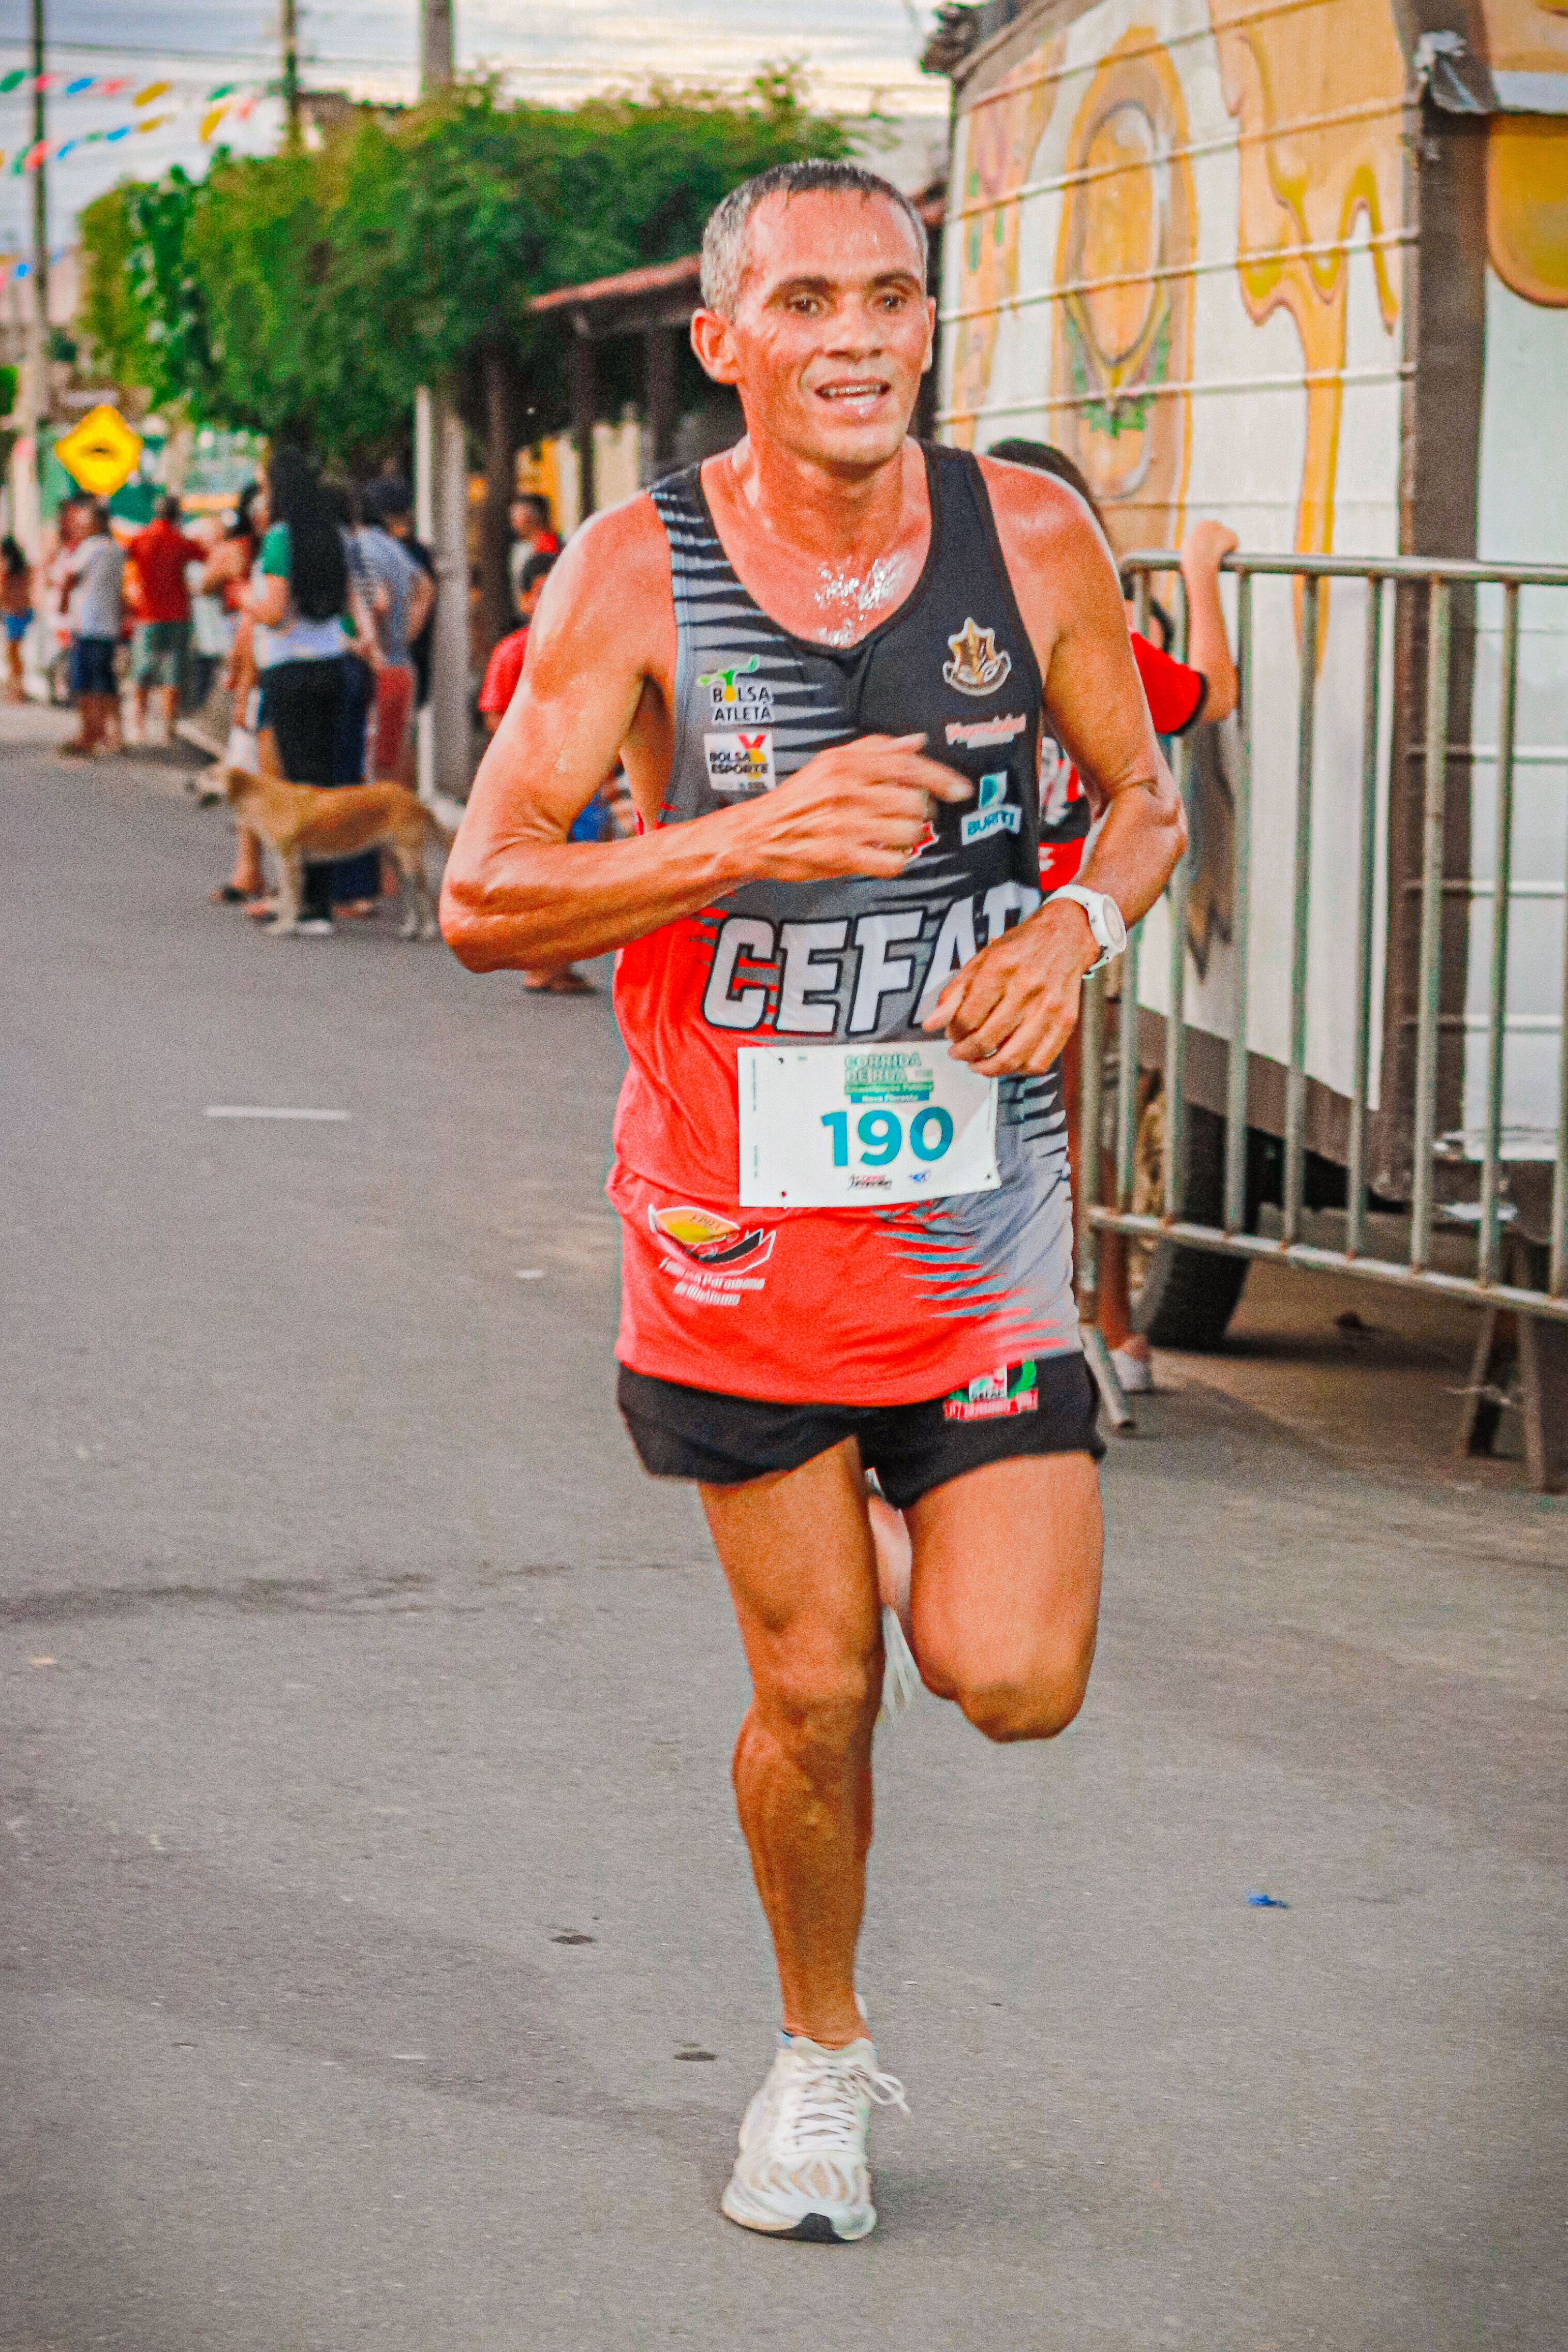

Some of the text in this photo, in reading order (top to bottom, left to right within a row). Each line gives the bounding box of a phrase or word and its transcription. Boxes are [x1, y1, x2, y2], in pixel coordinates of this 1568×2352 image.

[715, 706, 772, 721] ATLETA
[709, 751, 751, 763] BOLSA
[711, 762, 769, 774] ESPORTE
[845, 1052, 922, 1069] CORRIDA
[821, 1106, 954, 1167] 190
